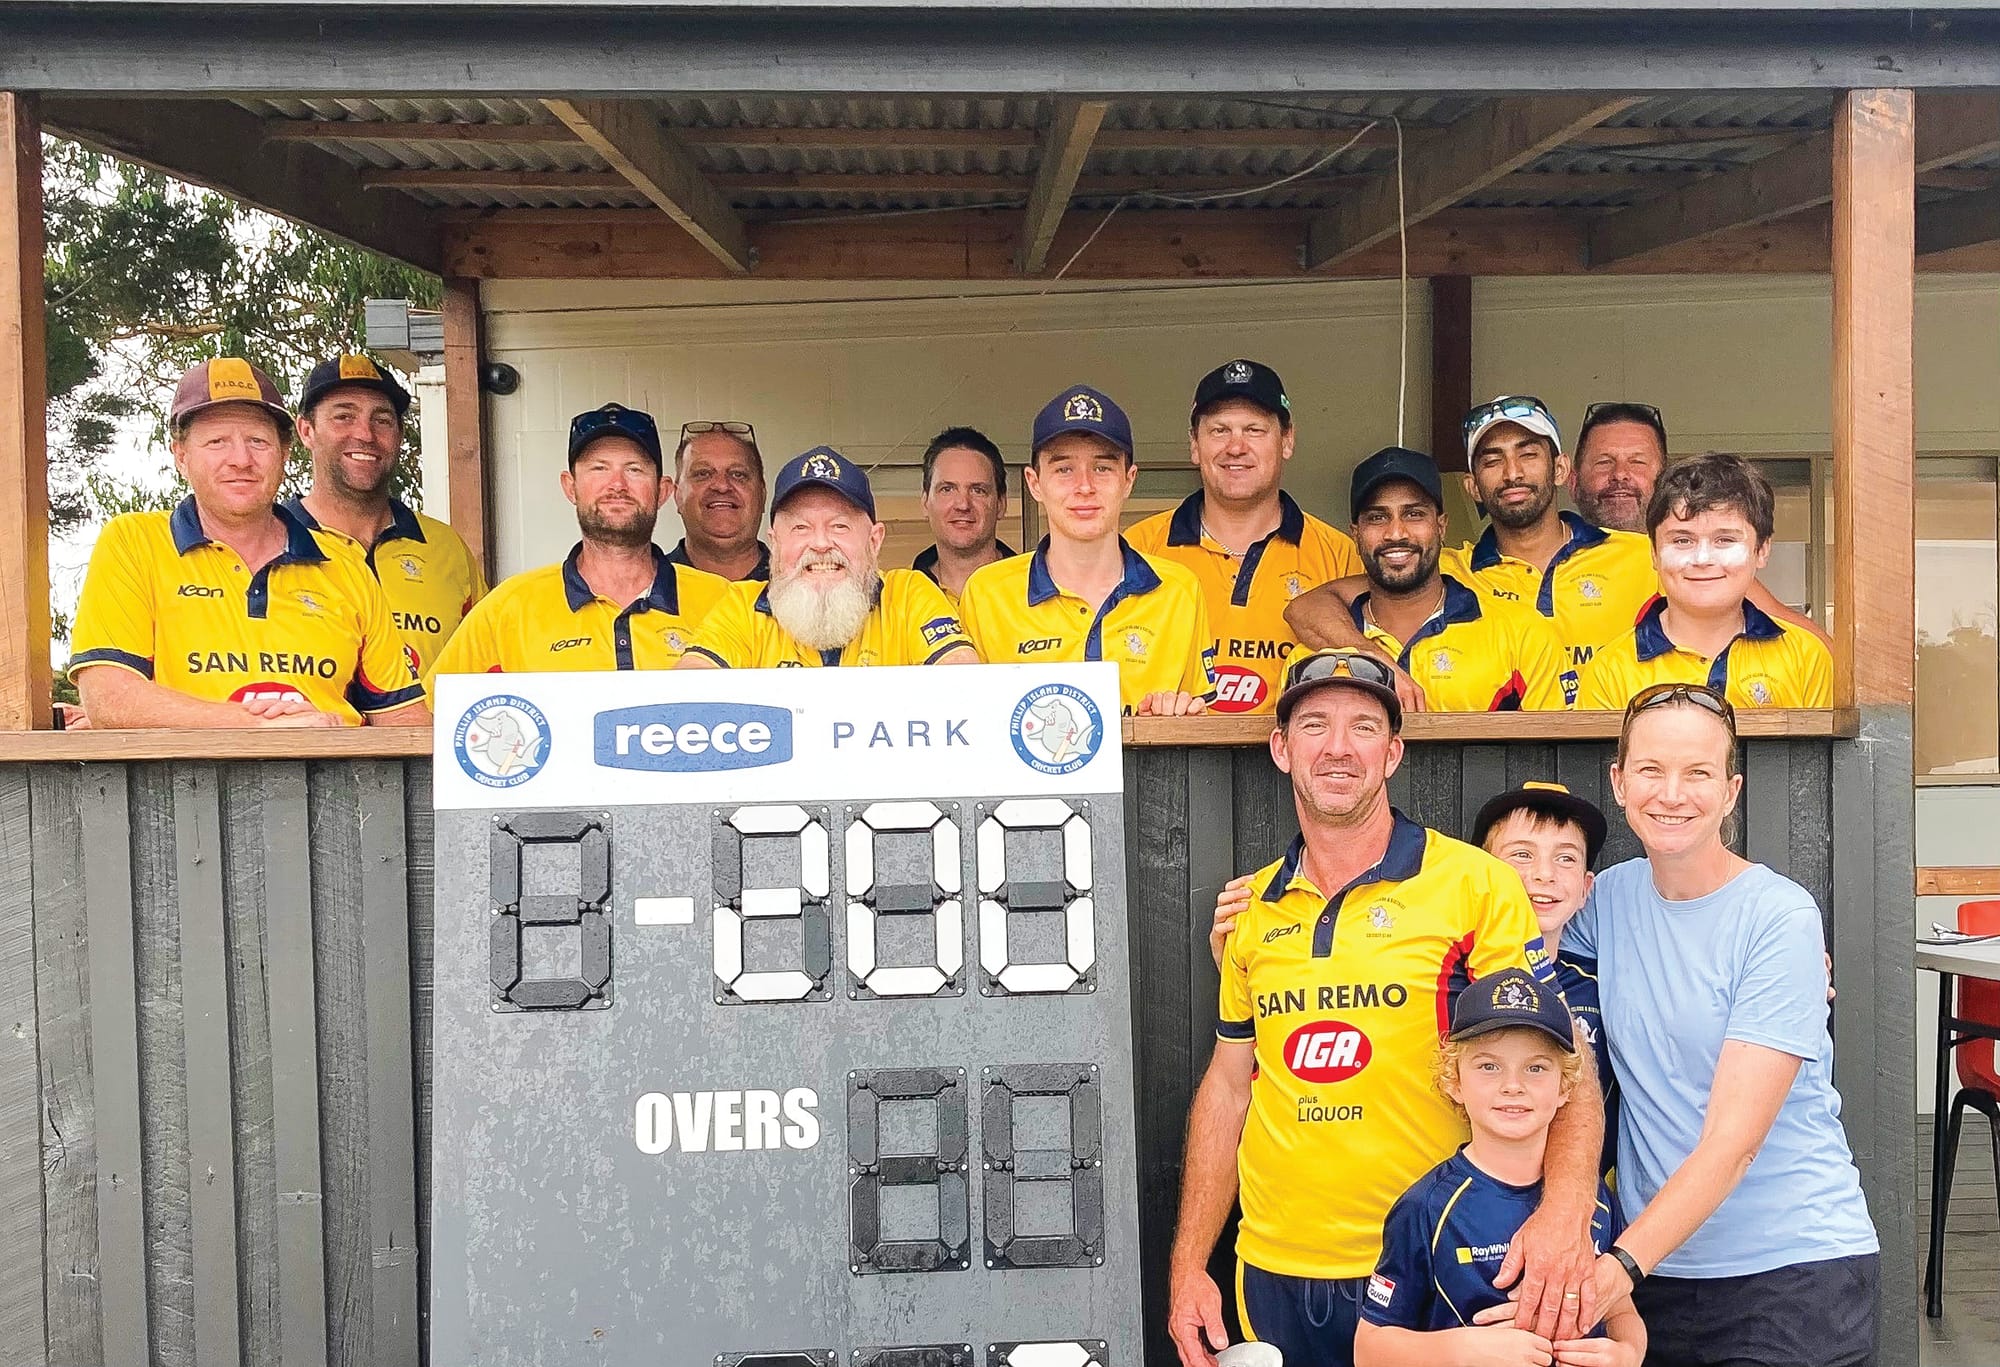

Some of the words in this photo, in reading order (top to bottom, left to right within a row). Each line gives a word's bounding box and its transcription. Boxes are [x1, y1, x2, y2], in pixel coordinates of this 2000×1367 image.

[392, 612, 441, 634] EMO
[1229, 638, 1295, 660] REMO
[187, 652, 249, 674] SAN
[259, 652, 337, 679] REMO
[1011, 701, 1027, 735] PHILLIP
[1026, 686, 1059, 703] ISLAND
[1062, 687, 1097, 715] DISTRICT
[455, 712, 473, 748] PHILLIP
[472, 697, 507, 715] ISLAND
[510, 698, 546, 727] DISTRICT
[615, 720, 772, 756] reece
[833, 719, 970, 749] PARK
[1031, 759, 1062, 774] CRICKET
[1063, 759, 1084, 773] CLUB
[474, 772, 507, 787] CRICKET
[508, 772, 530, 786] CLUB
[1258, 988, 1305, 1018] SAN
[1318, 983, 1407, 1010] REMO
[1298, 1095, 1318, 1107] plus
[635, 1087, 821, 1155] OVERS
[1298, 1106, 1363, 1122] LIQUOR
[1369, 1289, 1389, 1304] QUOR
